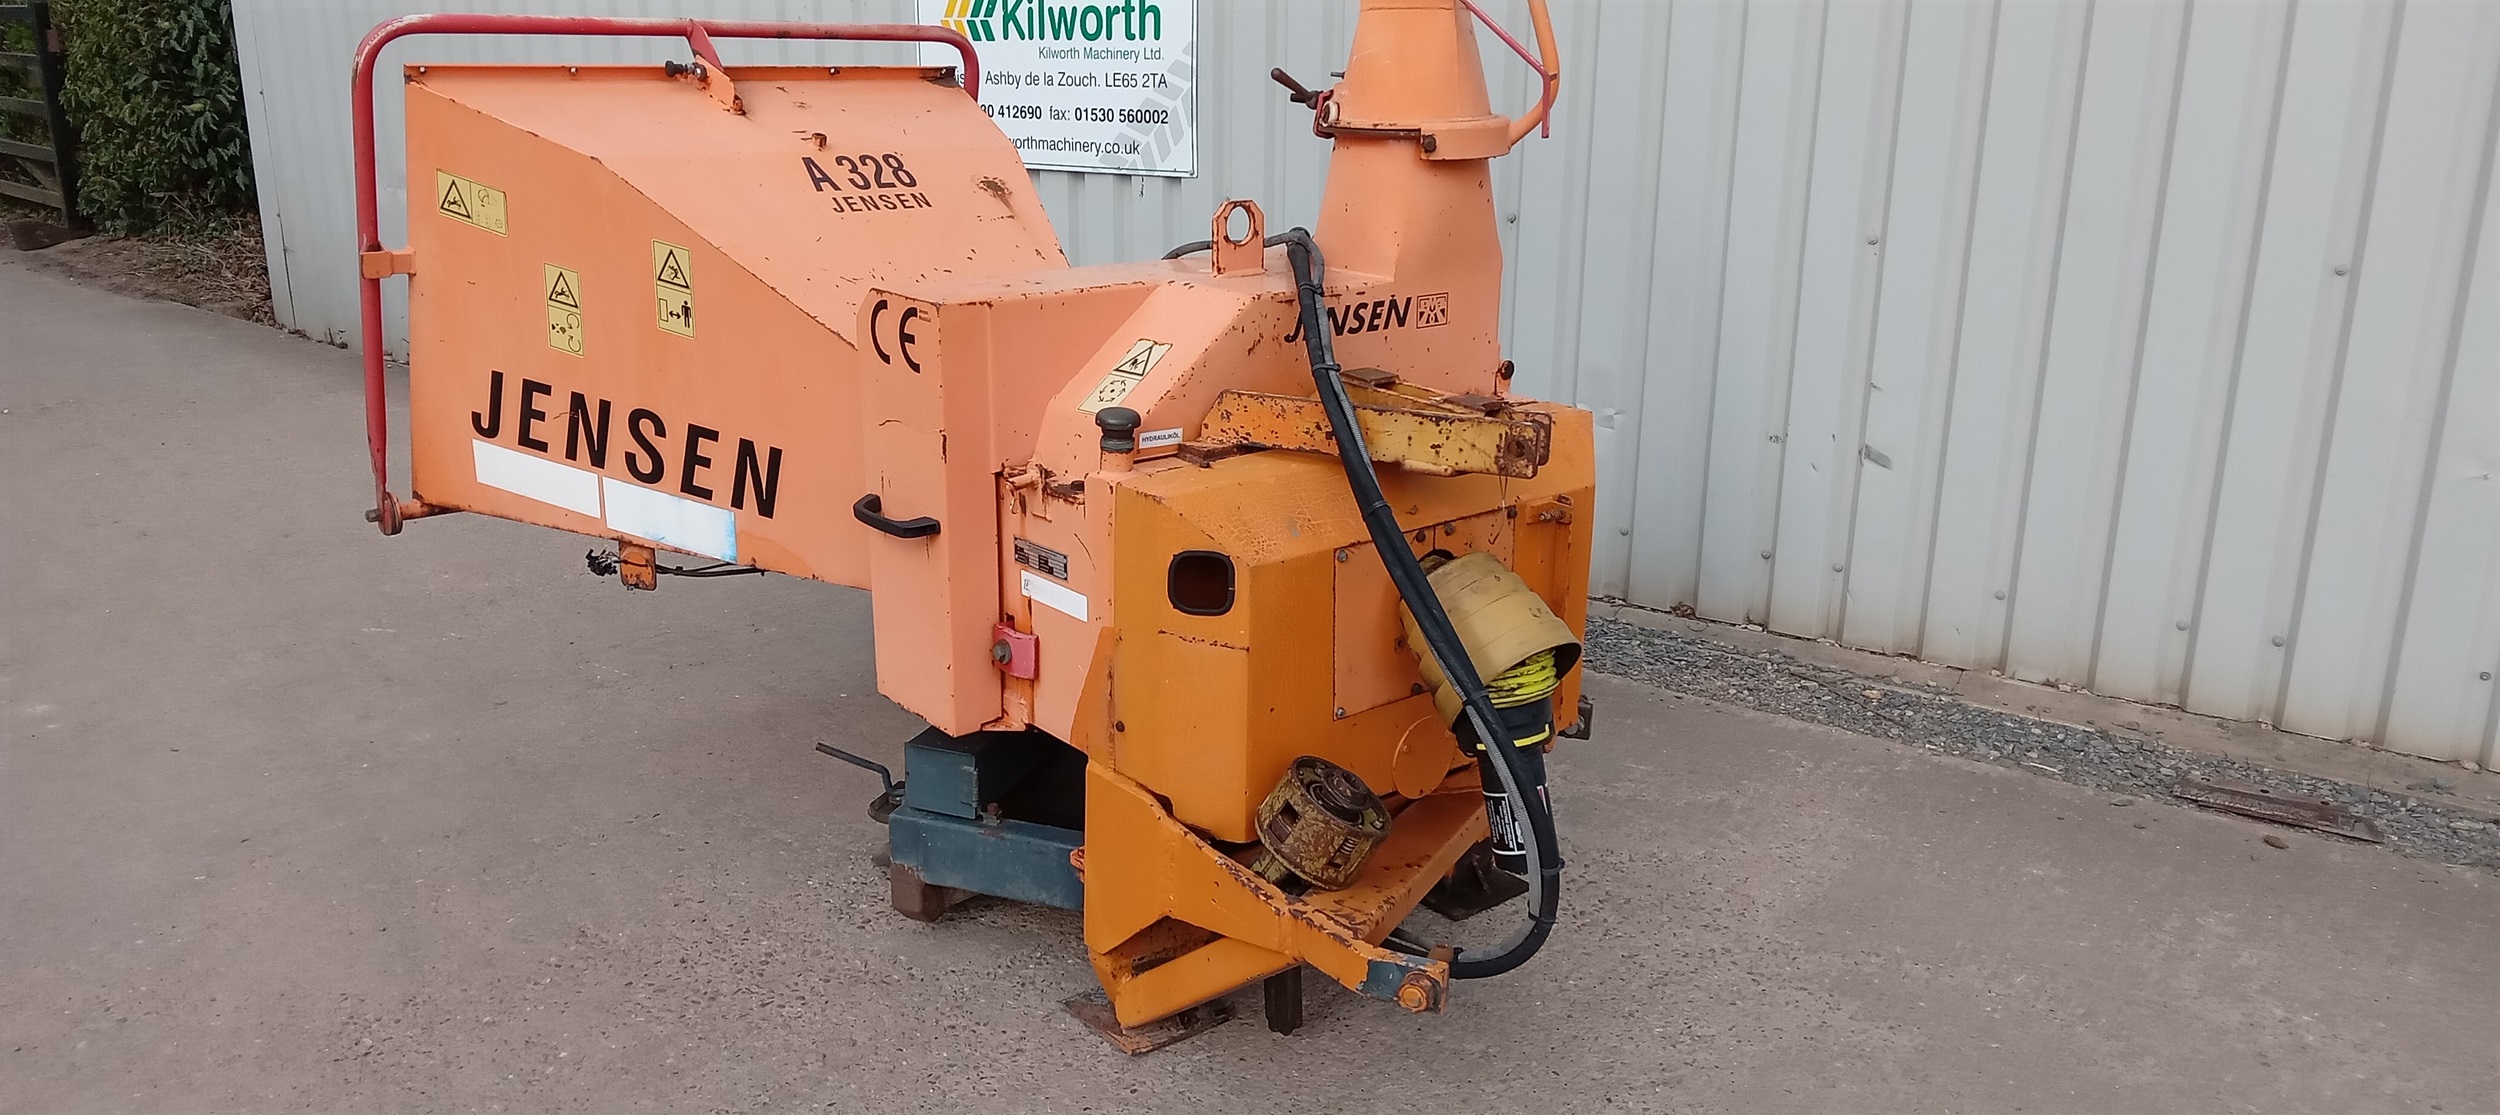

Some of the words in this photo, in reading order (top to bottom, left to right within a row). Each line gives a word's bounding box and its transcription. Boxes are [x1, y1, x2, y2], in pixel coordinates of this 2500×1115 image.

[1002, 0, 1161, 41] Kilworth
[1038, 46, 1080, 60] Kilworth
[1083, 46, 1141, 63] Machinery
[1143, 47, 1164, 60] Ltd.
[985, 70, 1021, 90] Ashby
[1024, 71, 1040, 86] de
[1043, 71, 1055, 86] la
[1057, 71, 1101, 88] Zouch.
[1105, 72, 1138, 88] LE65
[1142, 73, 1168, 88] 2TA
[998, 104, 1042, 120] 412690
[1048, 105, 1071, 121] fax:
[1074, 107, 1115, 123] 01530
[1118, 108, 1169, 124] 560002
[1008, 135, 1141, 157] orthmachinery.co.uk
[801, 156, 842, 192] A
[835, 153, 918, 190] 328
[831, 192, 933, 213] JENSEN
[1284, 296, 1413, 343] JNSEN
[870, 299, 921, 374] CE
[470, 369, 784, 520] JENSEN
